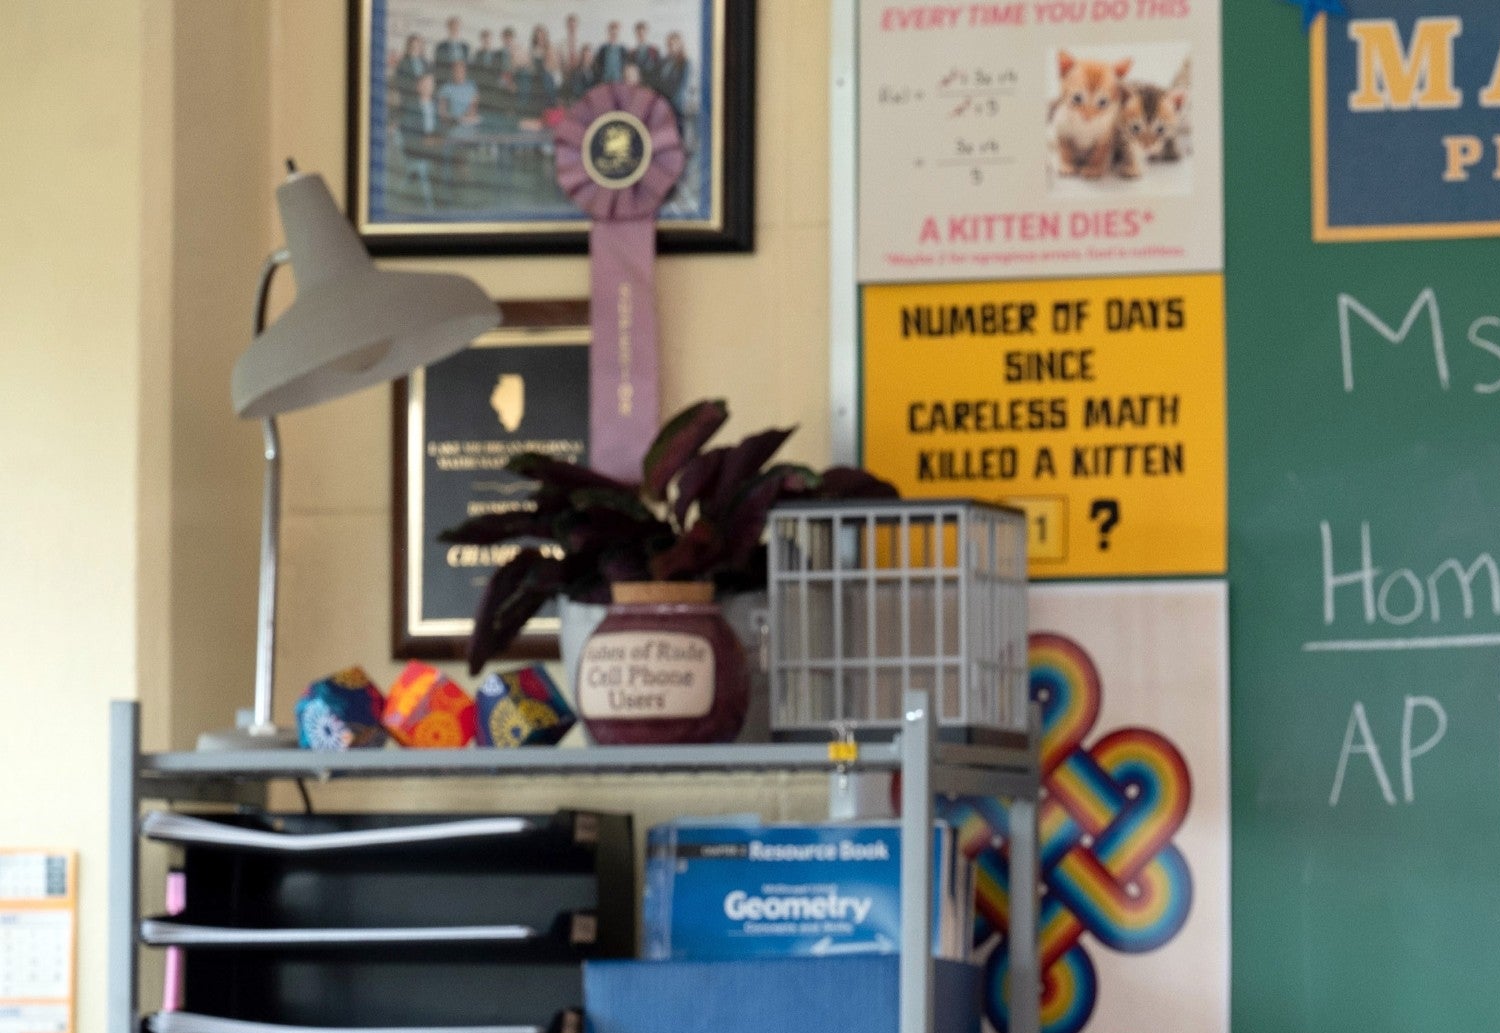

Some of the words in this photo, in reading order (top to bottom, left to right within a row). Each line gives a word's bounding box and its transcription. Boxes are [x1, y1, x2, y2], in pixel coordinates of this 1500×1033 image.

[881, 6, 963, 30] EVERY
[968, 1, 1026, 27] TIME
[1035, 0, 1087, 23] YOU
[1091, 0, 1129, 22] DO
[1136, 0, 1190, 20] THIS
[918, 215, 941, 245] A
[947, 211, 1060, 244] KITTEN
[900, 302, 1037, 339] NUMBER
[1052, 300, 1091, 334] OF
[1106, 296, 1185, 332] DAYS
[1003, 348, 1096, 384] SINCE
[907, 397, 1068, 435] CARELESS
[1083, 394, 1181, 430] MATH
[916, 446, 1019, 483] KILLED
[1033, 446, 1056, 479] A
[1072, 443, 1186, 478] KITTEN
[1089, 499, 1121, 550] ?
[588, 665, 623, 687] Cell
[628, 664, 695, 687] Phone
[608, 690, 666, 710] Users
[1329, 695, 1448, 805] AP
[748, 841, 836, 862] Resource
[838, 839, 890, 861] Book
[723, 890, 873, 923] Geometry
